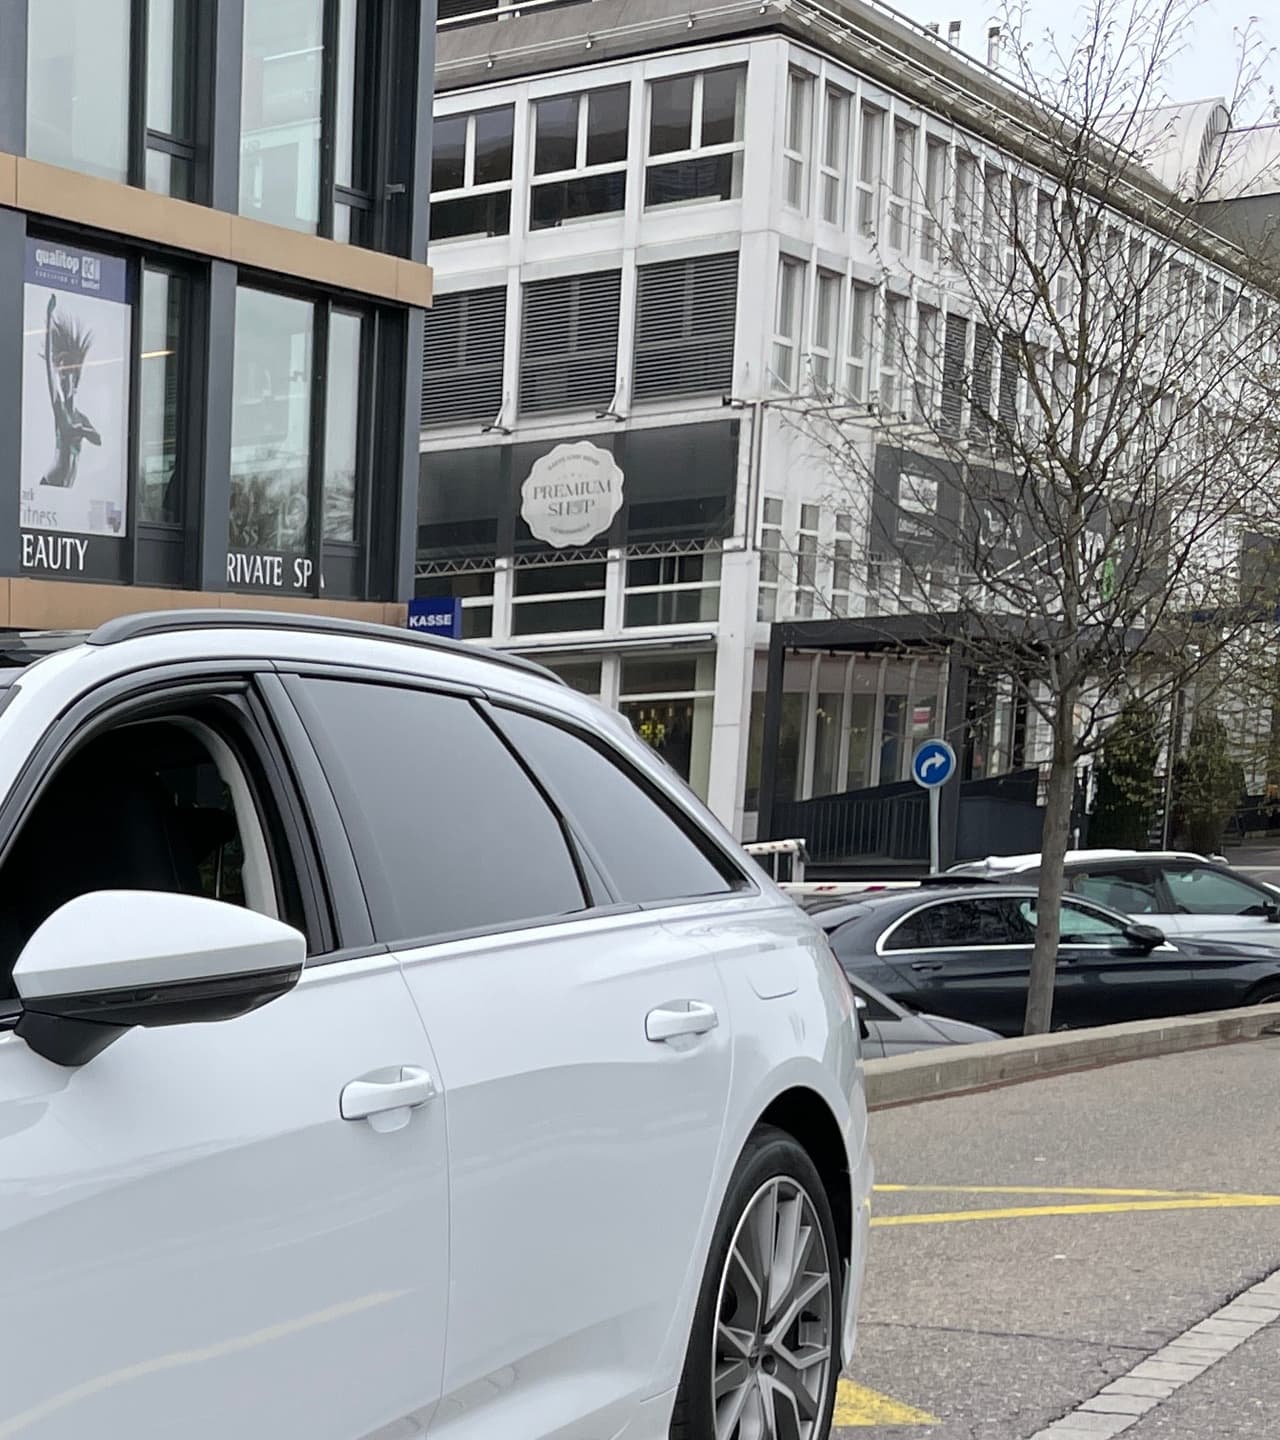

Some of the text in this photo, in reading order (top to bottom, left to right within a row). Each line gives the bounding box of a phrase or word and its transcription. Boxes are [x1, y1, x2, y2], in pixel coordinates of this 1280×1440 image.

[35, 248, 80, 275] qualitop
[532, 479, 612, 501] PREMIUM
[20, 534, 89, 571] EAUTY
[226, 552, 283, 586] RIVATE
[409, 613, 452, 627] KASSE
